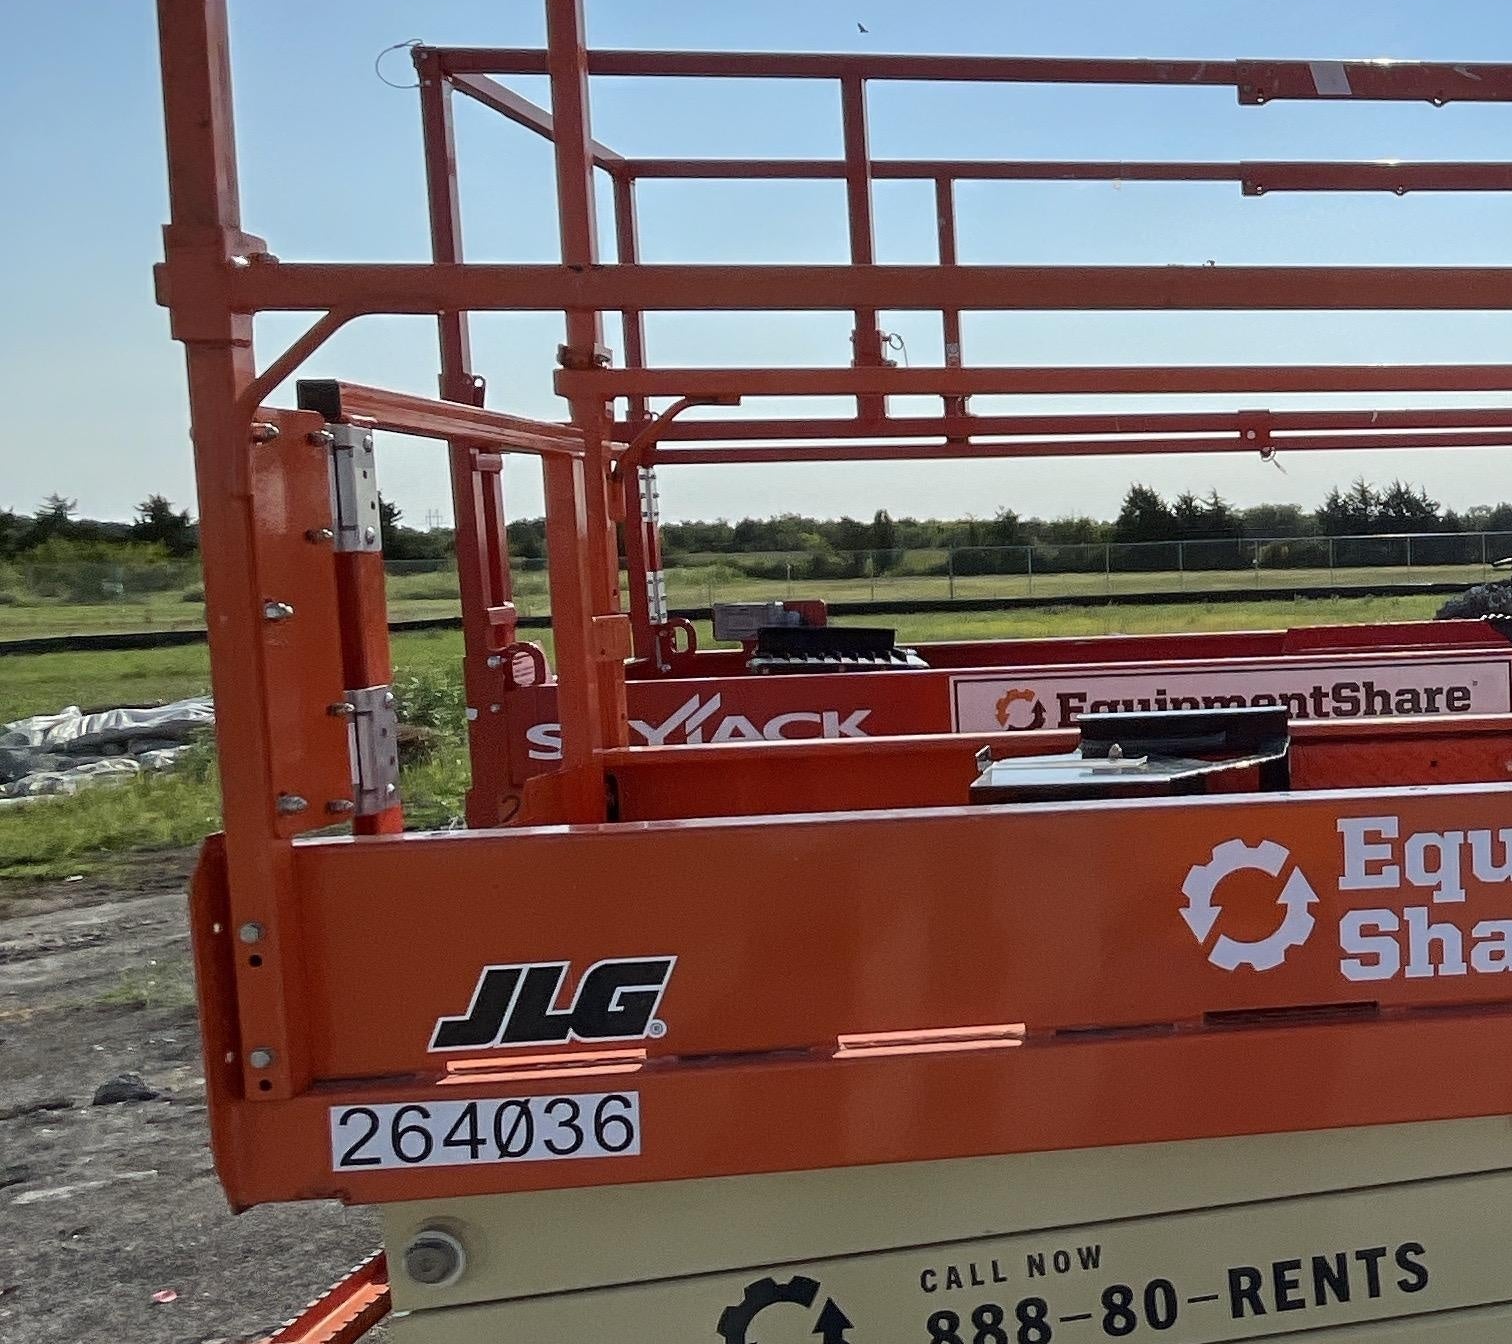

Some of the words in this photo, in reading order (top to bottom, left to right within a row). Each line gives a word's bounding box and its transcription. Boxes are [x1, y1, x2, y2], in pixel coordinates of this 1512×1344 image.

[526, 691, 872, 760] SYJACK
[428, 956, 677, 1052] JLG
[338, 1095, 635, 1167] 264036
[919, 1262, 1008, 1294] CALL
[1026, 1244, 1103, 1279] NOW
